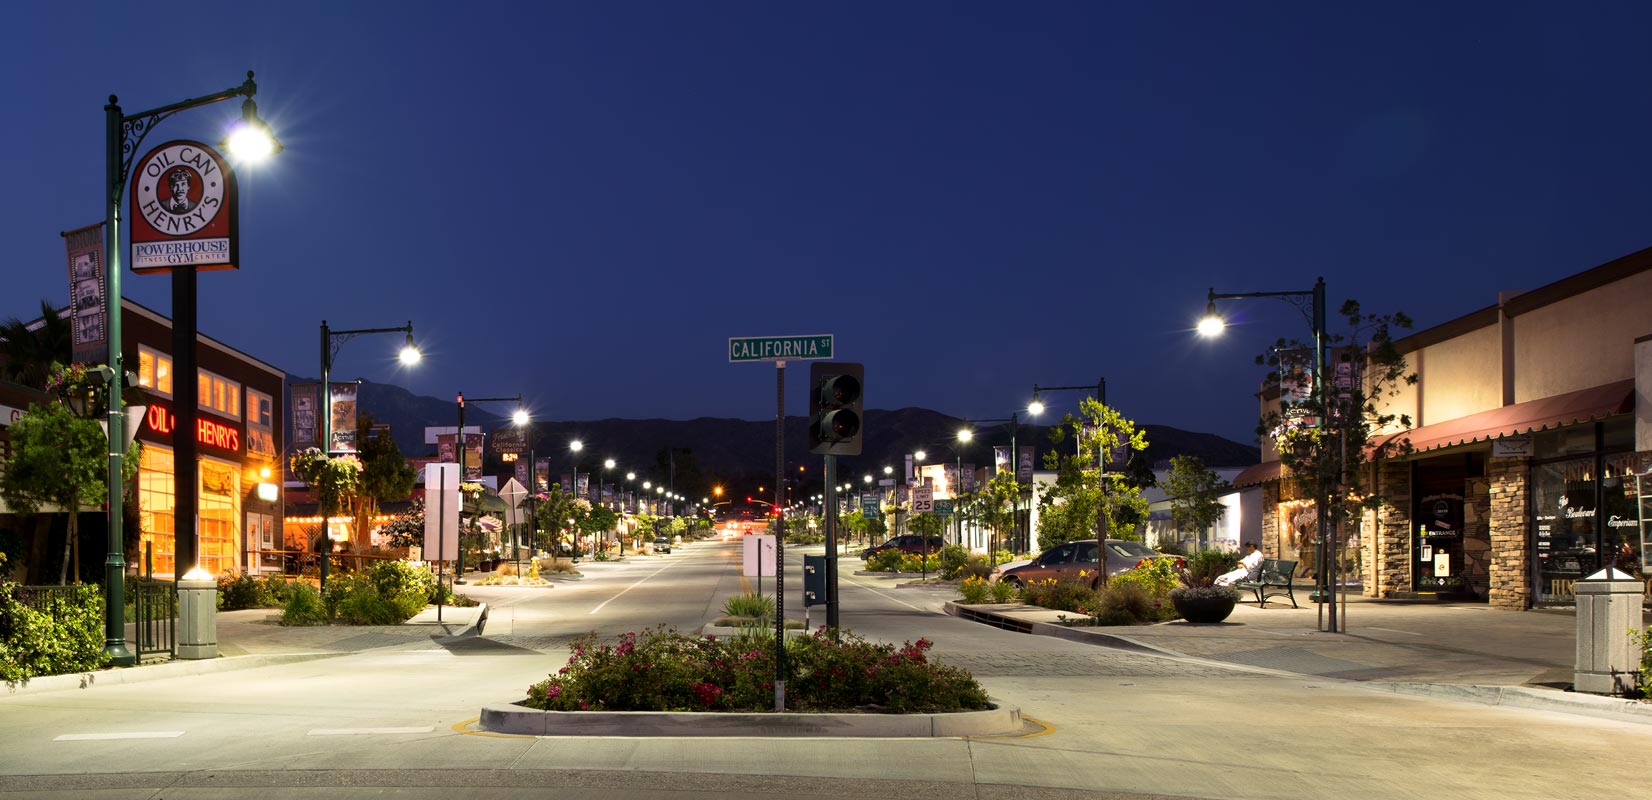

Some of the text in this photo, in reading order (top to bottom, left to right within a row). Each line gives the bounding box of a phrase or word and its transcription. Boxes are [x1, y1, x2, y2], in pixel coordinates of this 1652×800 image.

[147, 148, 216, 177] OIL CAN
[143, 196, 219, 232] HENRY'S
[136, 240, 227, 256] POWERHOUSE
[168, 253, 194, 263] GYM
[732, 339, 830, 357] CALIFORNIA ST
[148, 404, 169, 433] OIL
[197, 418, 239, 451] HENRY'S
[915, 501, 931, 510] 25
[1566, 506, 1596, 518] Boulevard
[1608, 515, 1638, 529] Emporium
